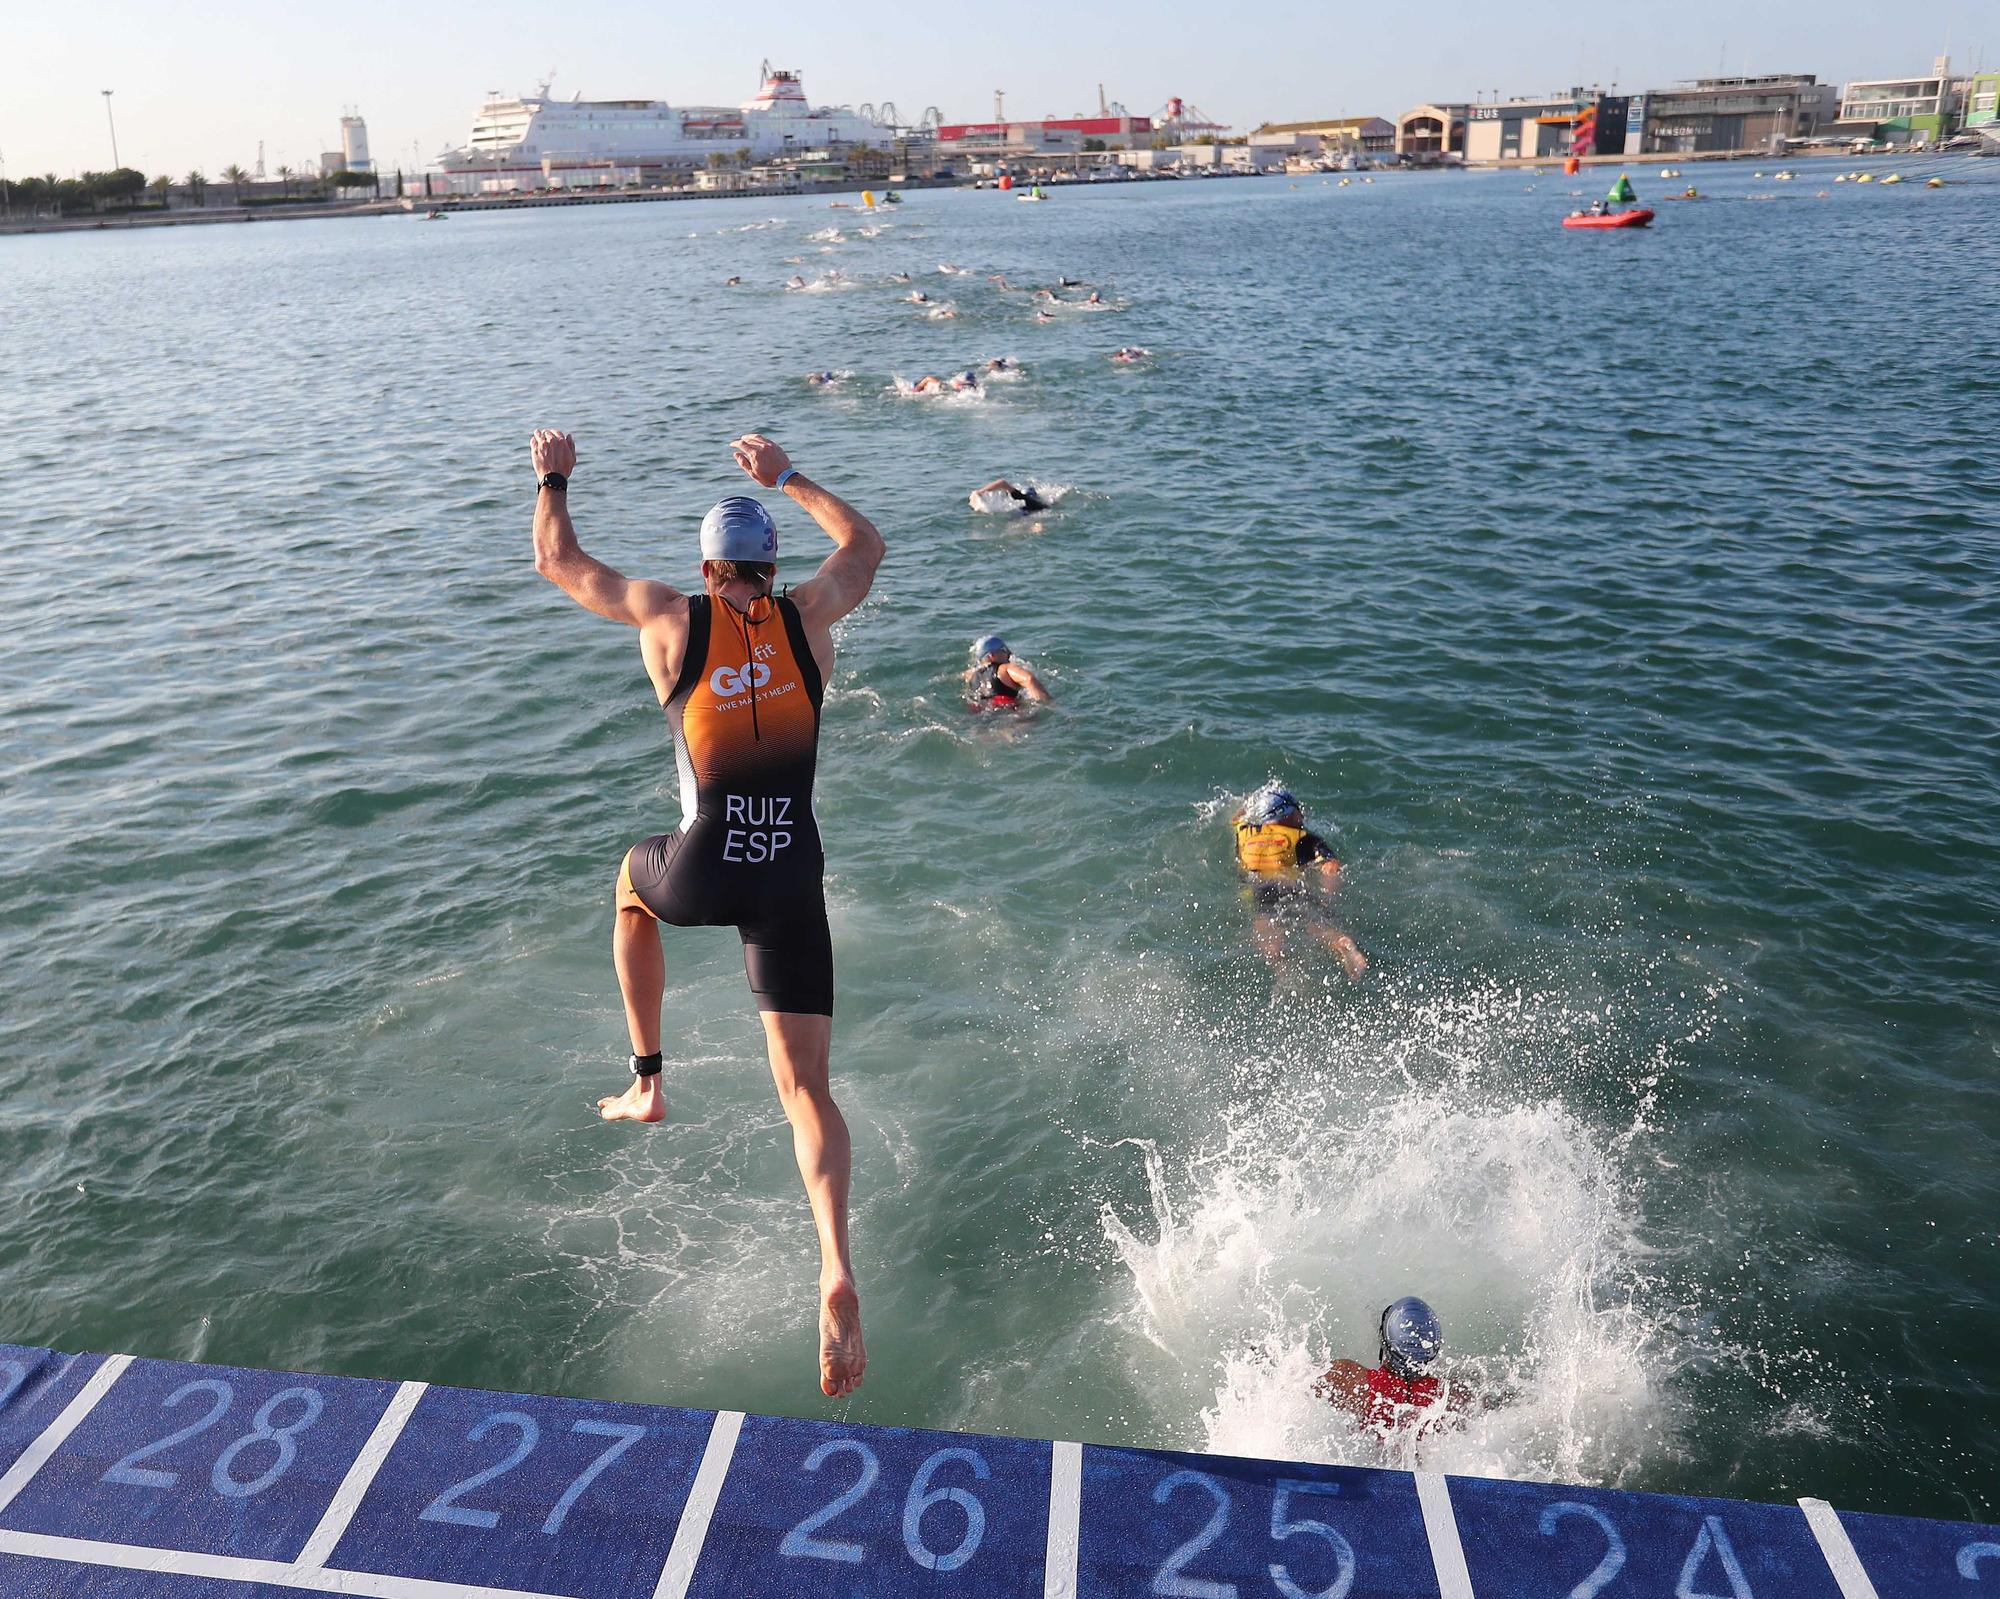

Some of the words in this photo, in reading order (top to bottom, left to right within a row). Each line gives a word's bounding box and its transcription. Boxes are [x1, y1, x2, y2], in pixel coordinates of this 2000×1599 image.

[710, 662, 772, 697] GO
[754, 643, 777, 661] fit
[715, 701, 738, 712] VIVE
[769, 681, 797, 697] MEJOR
[722, 829, 792, 863] ESP
[726, 794, 794, 826] RUIZ
[101, 1379, 325, 1498] 28
[418, 1411, 648, 1535] 27
[779, 1439, 992, 1571] 26
[1151, 1470, 1356, 1599] 25
